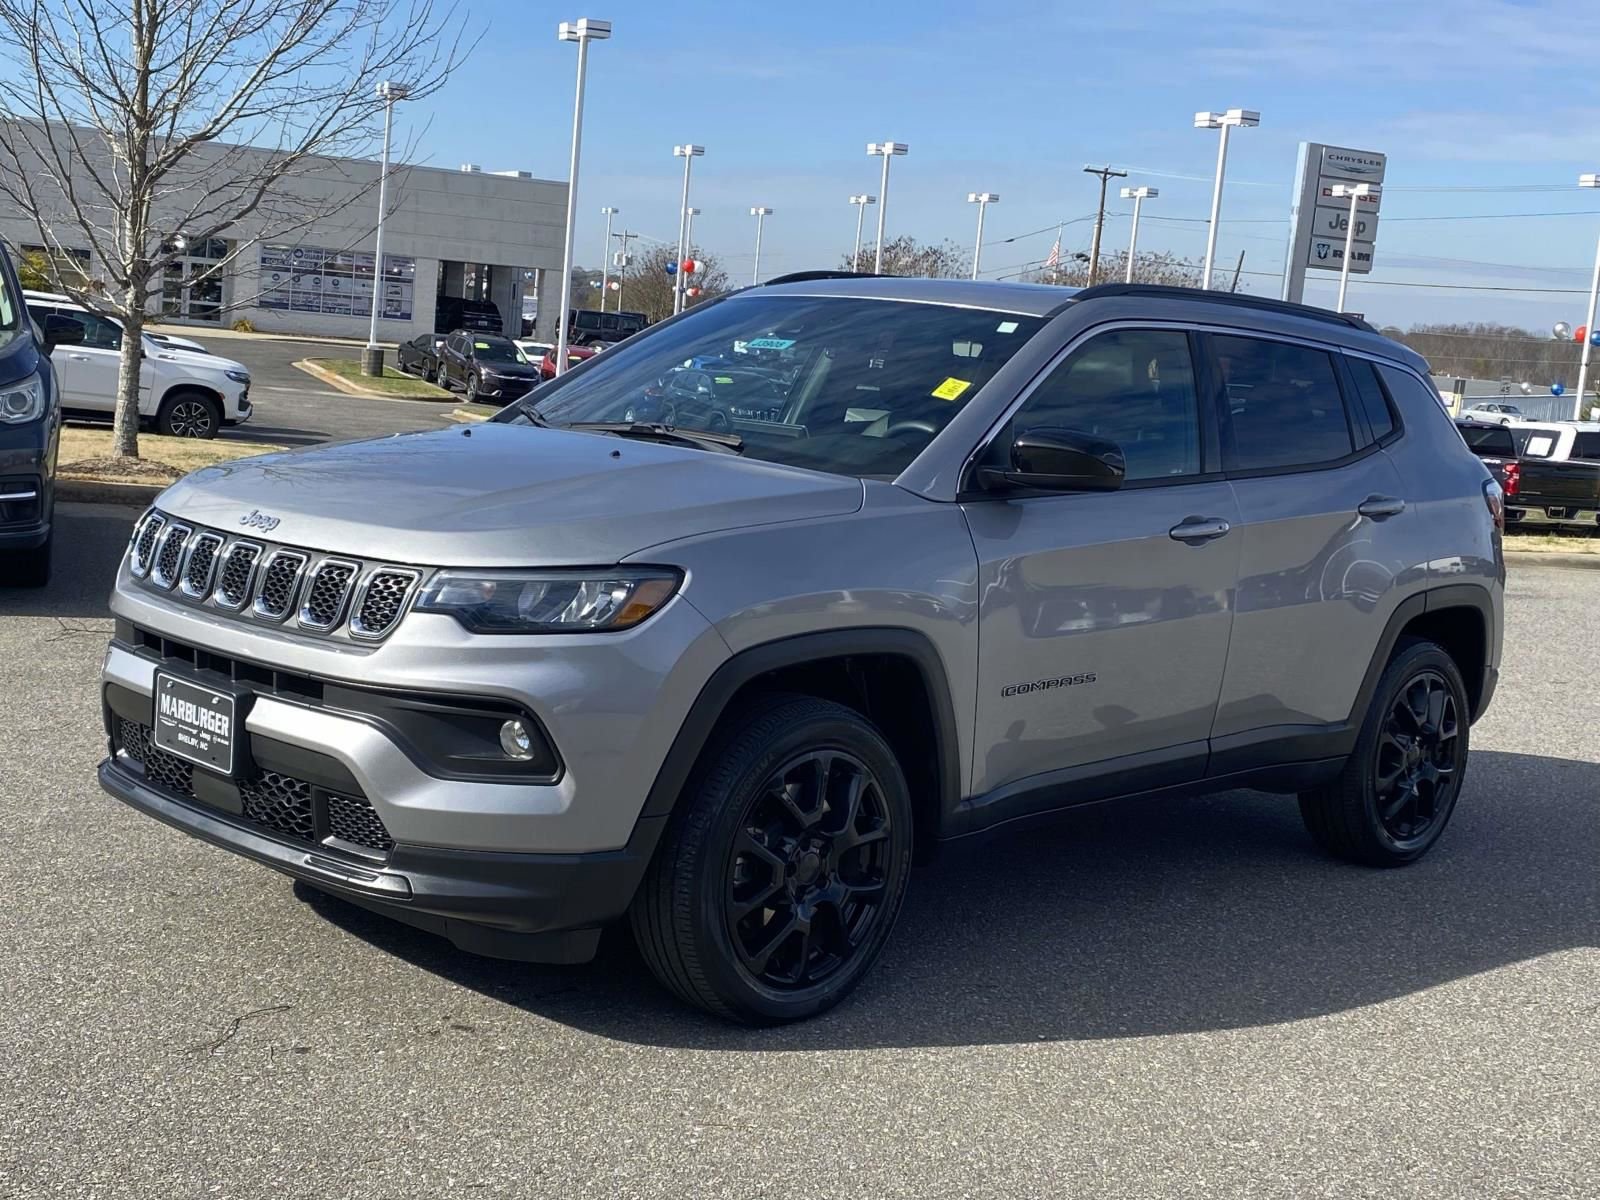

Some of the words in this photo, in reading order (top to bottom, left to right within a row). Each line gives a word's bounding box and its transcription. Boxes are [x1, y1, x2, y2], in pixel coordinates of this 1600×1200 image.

[1328, 153, 1382, 167] CHRYSLER
[1322, 187, 1378, 203] DGE
[1328, 213, 1367, 236] Jep
[239, 509, 280, 533] Jeep
[1001, 673, 1097, 697] COMPASS
[160, 693, 229, 737] MARBURGER
